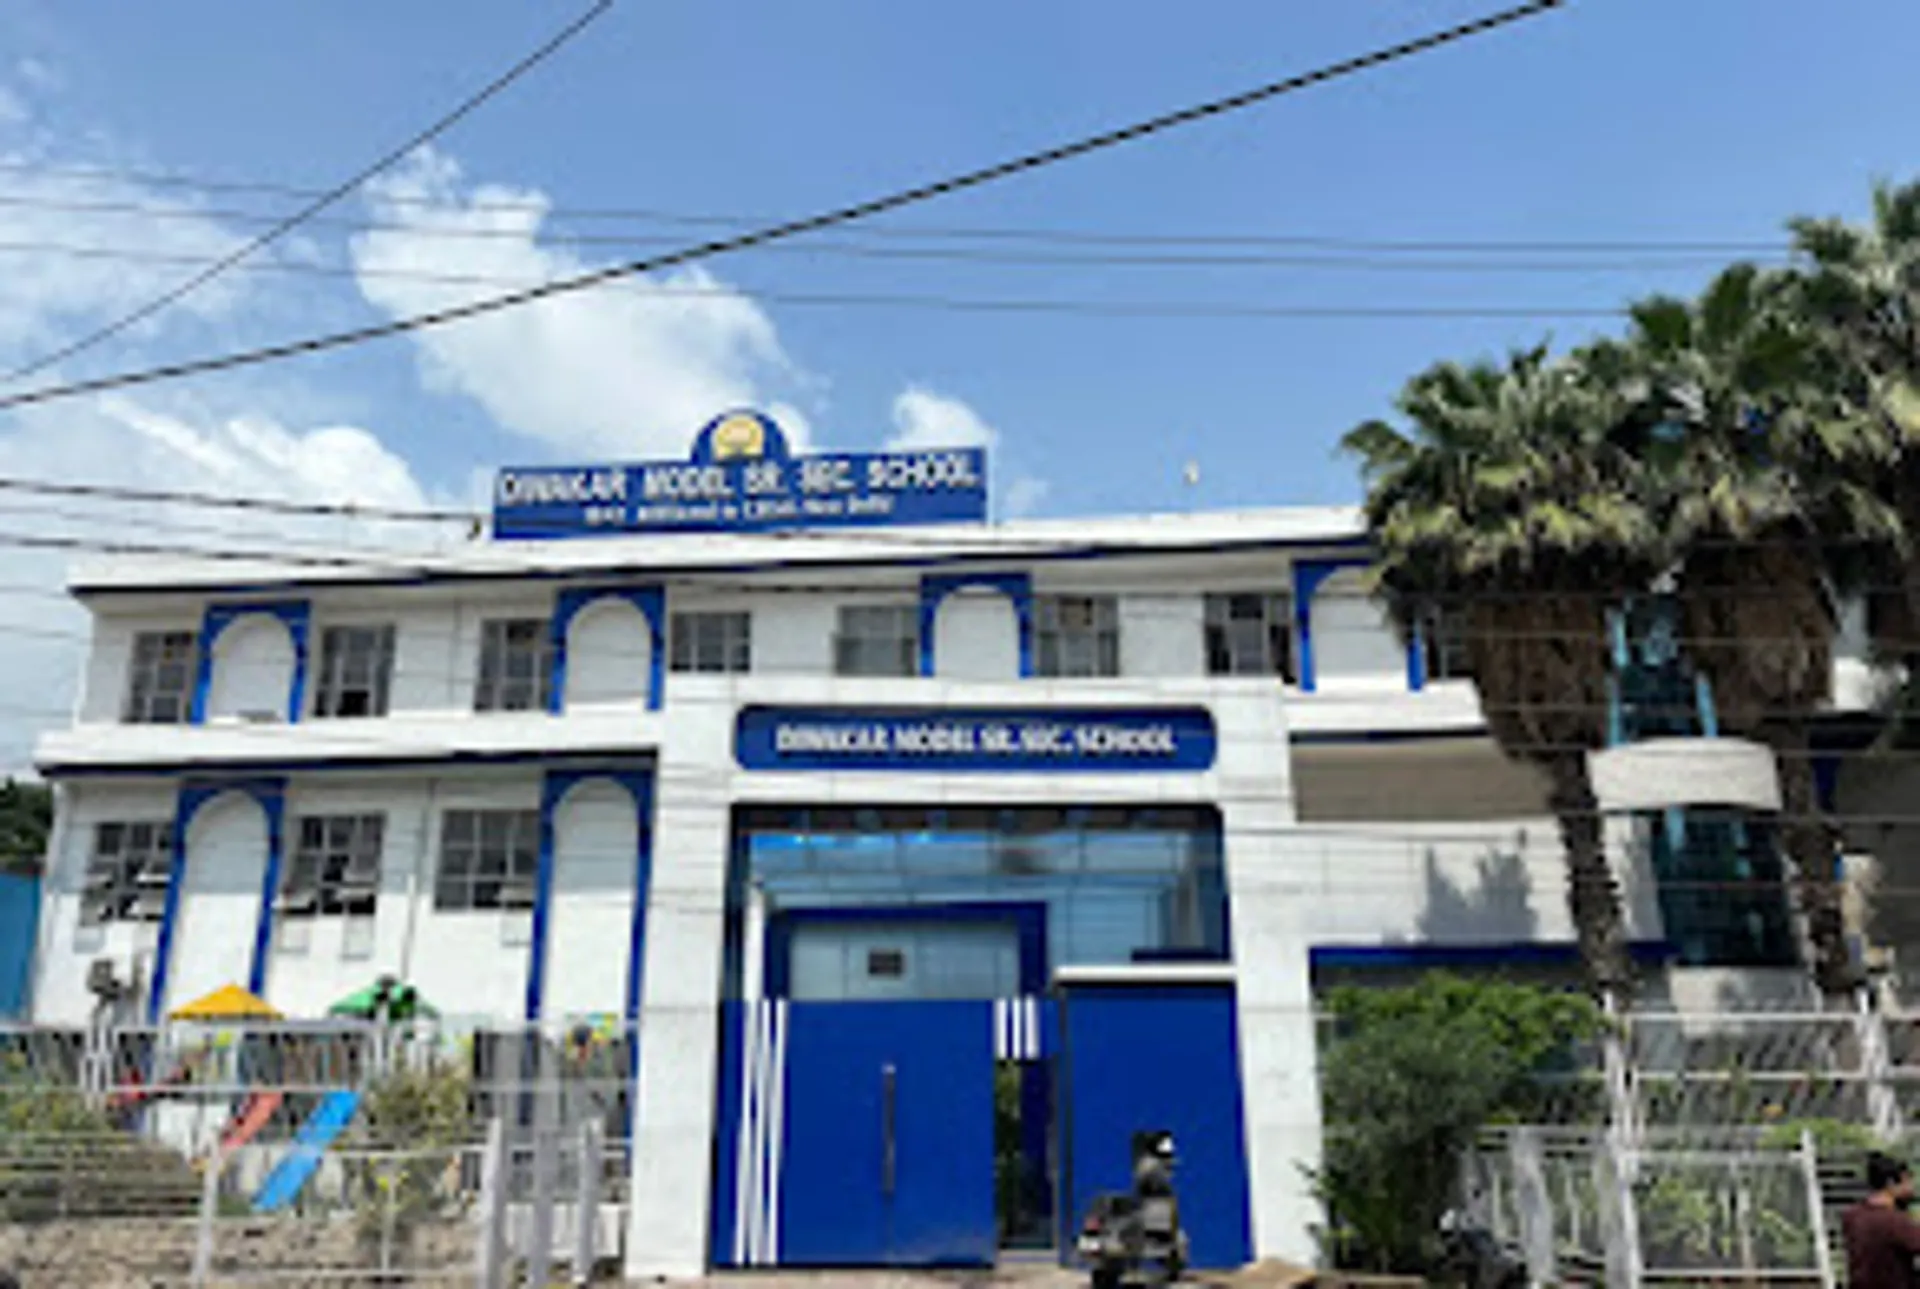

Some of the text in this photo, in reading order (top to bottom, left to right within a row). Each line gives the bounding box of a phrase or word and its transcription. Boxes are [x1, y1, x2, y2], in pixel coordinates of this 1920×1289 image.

[644, 465, 734, 499] MODEL
[867, 453, 978, 488] SCHOOL
[894, 722, 974, 753] MODEL
[1075, 722, 1178, 753] SCHOOL
